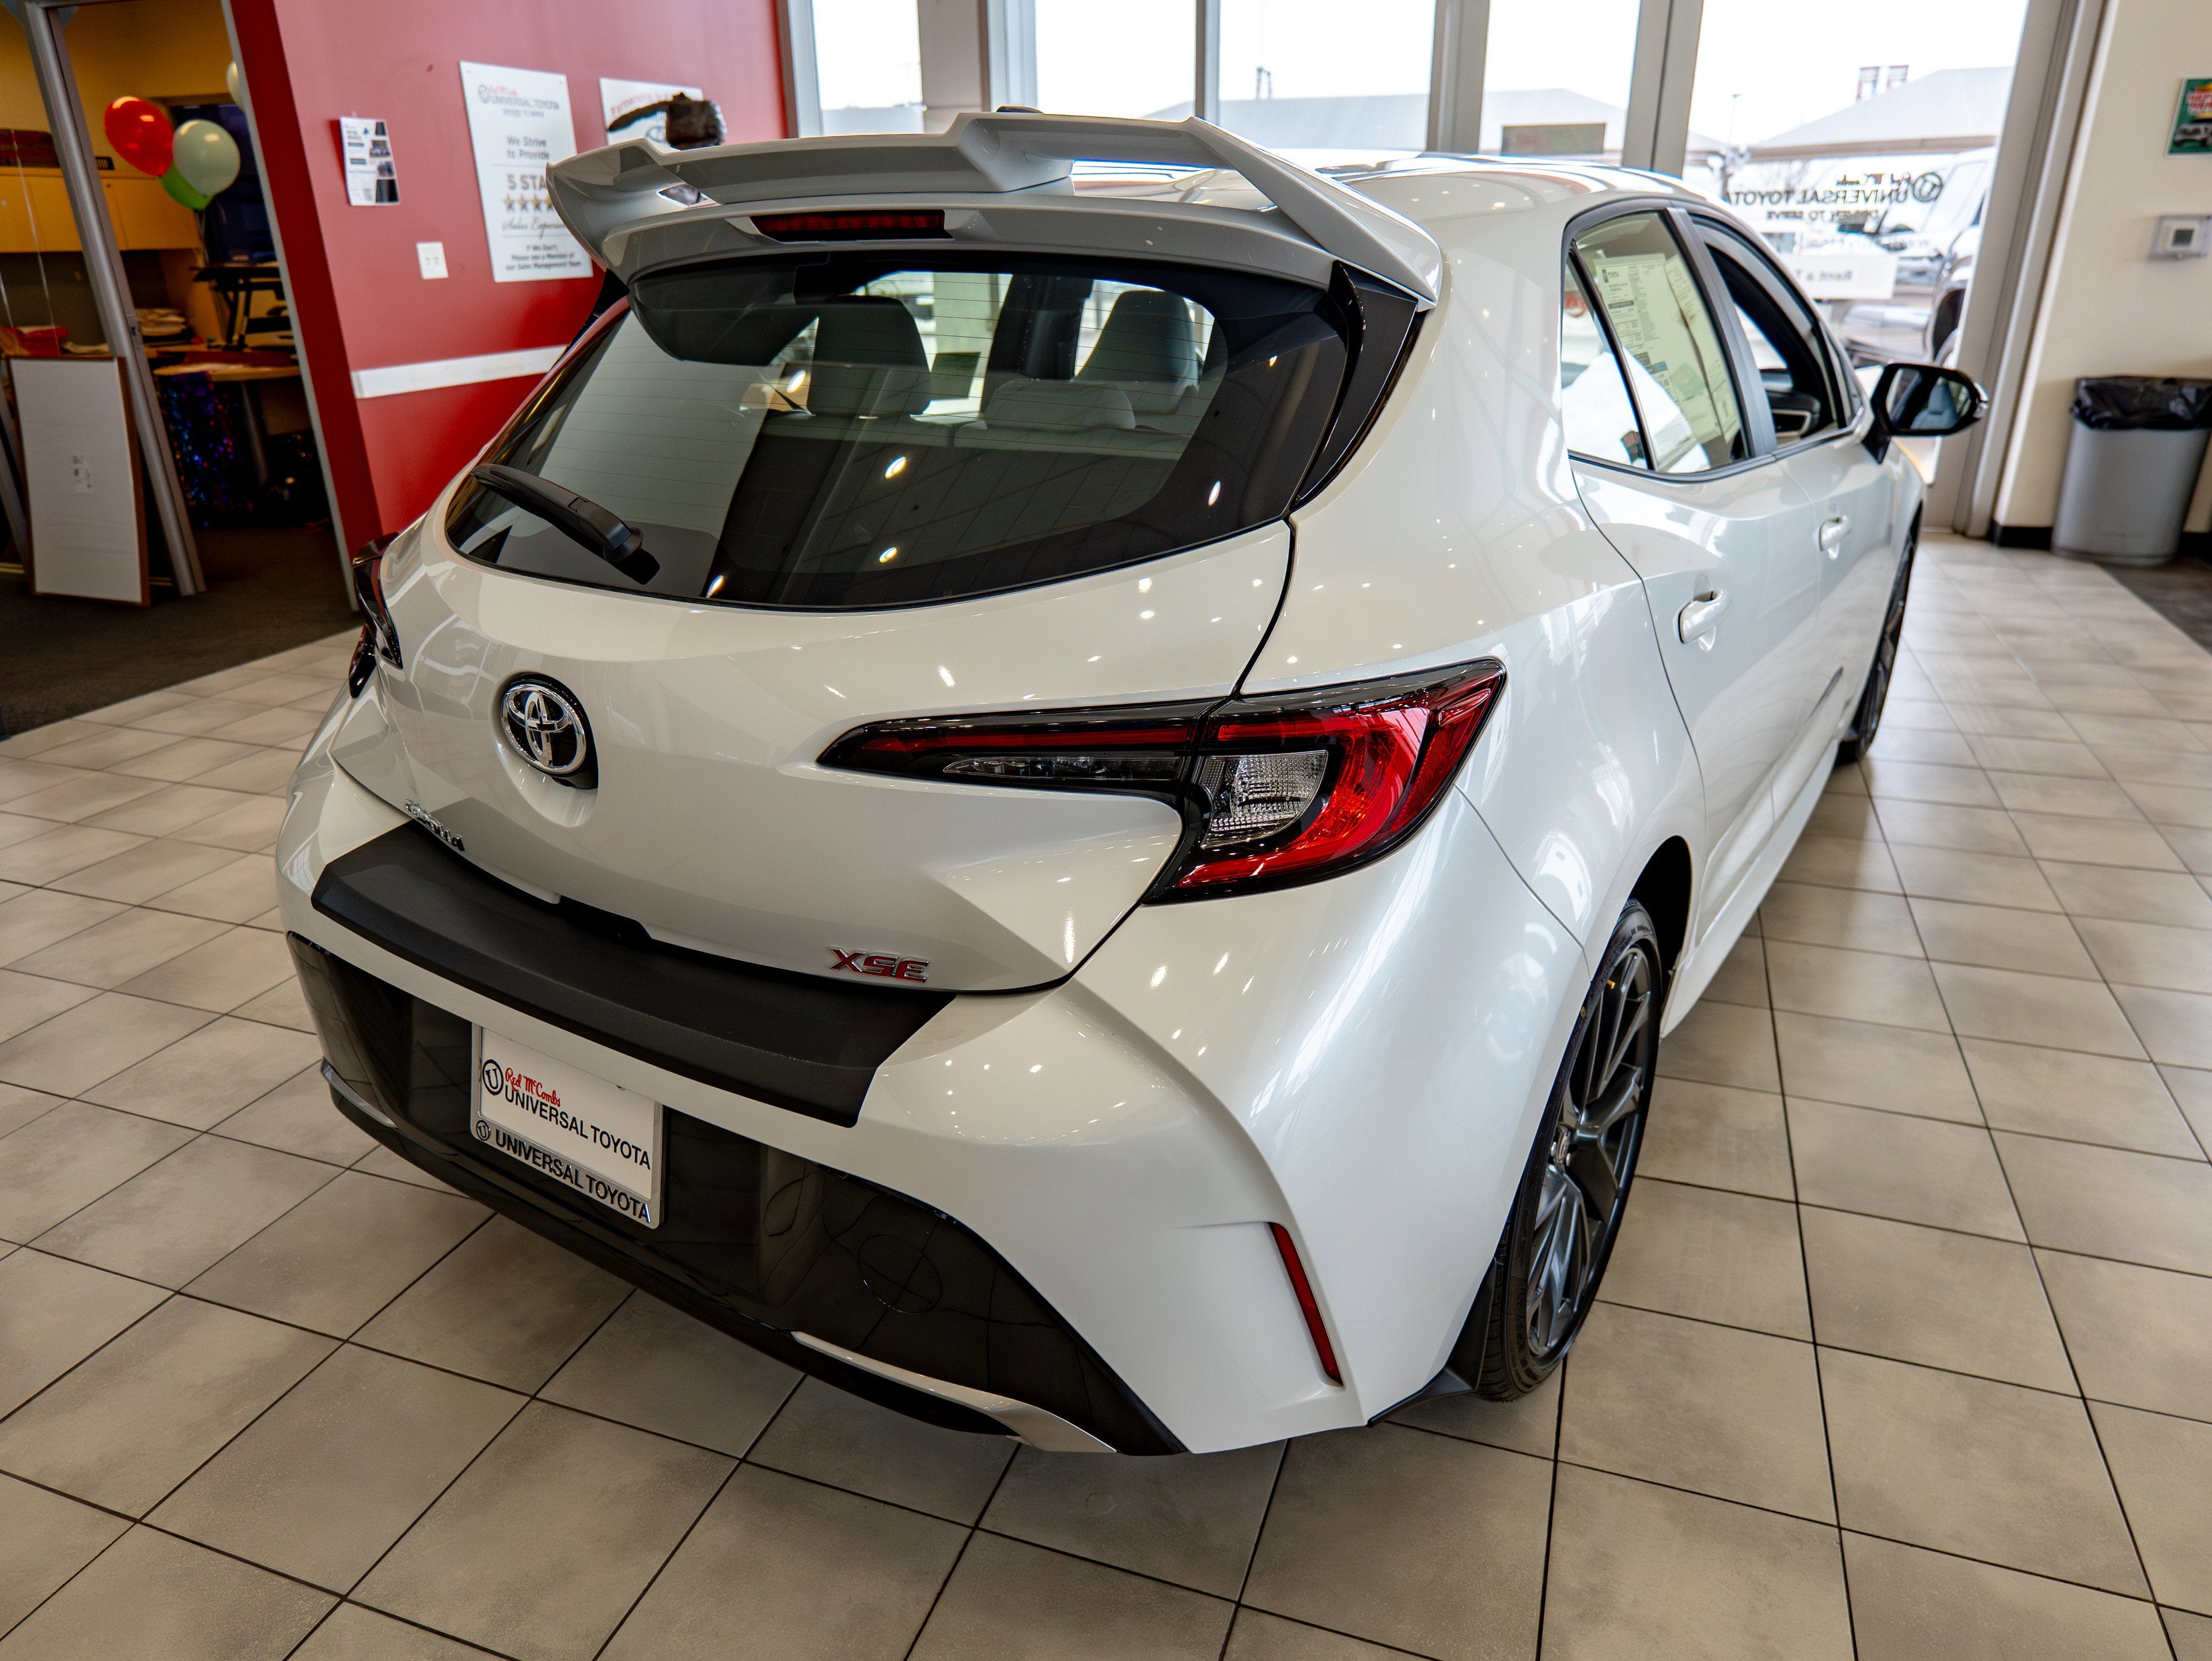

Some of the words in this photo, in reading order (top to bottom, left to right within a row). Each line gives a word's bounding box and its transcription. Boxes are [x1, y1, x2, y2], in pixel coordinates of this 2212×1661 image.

[507, 135, 520, 145] We
[523, 136, 547, 146] Strive
[507, 149, 516, 158] to
[519, 149, 550, 160] Provide
[507, 174, 516, 190] 5
[520, 174, 547, 191] STA
[829, 945, 930, 983] XSE
[505, 1067, 522, 1092] Red
[522, 1073, 561, 1107] McCombs
[505, 1084, 589, 1140] UNIVERSAL
[590, 1124, 652, 1171] TOYOTA
[495, 1128, 585, 1189] UNIVERSAL
[585, 1174, 652, 1224] TOYOTA
